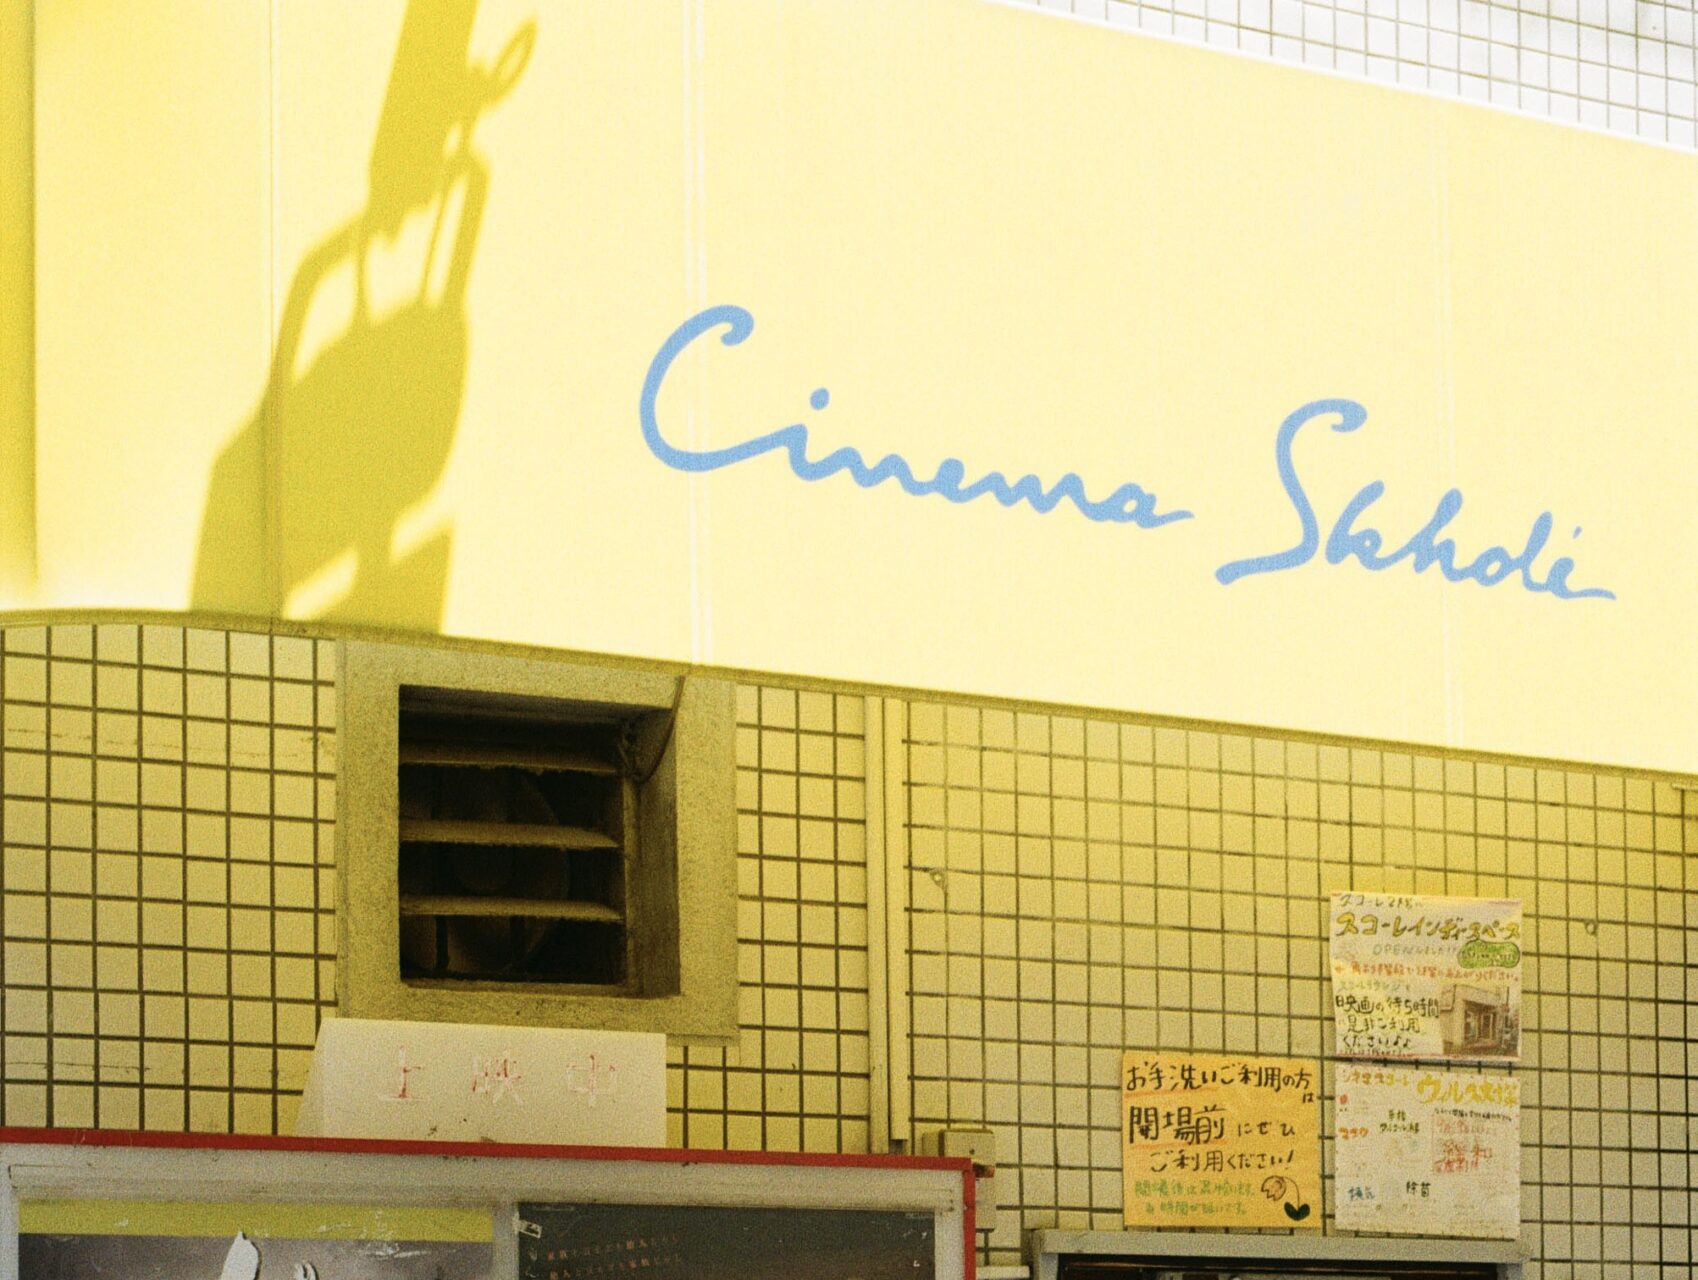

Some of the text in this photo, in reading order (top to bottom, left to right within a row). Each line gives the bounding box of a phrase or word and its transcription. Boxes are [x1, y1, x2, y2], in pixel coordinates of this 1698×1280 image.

[639, 304, 1194, 529] Cinema
[1126, 1061, 1312, 1092] お手洗いご利用の方
